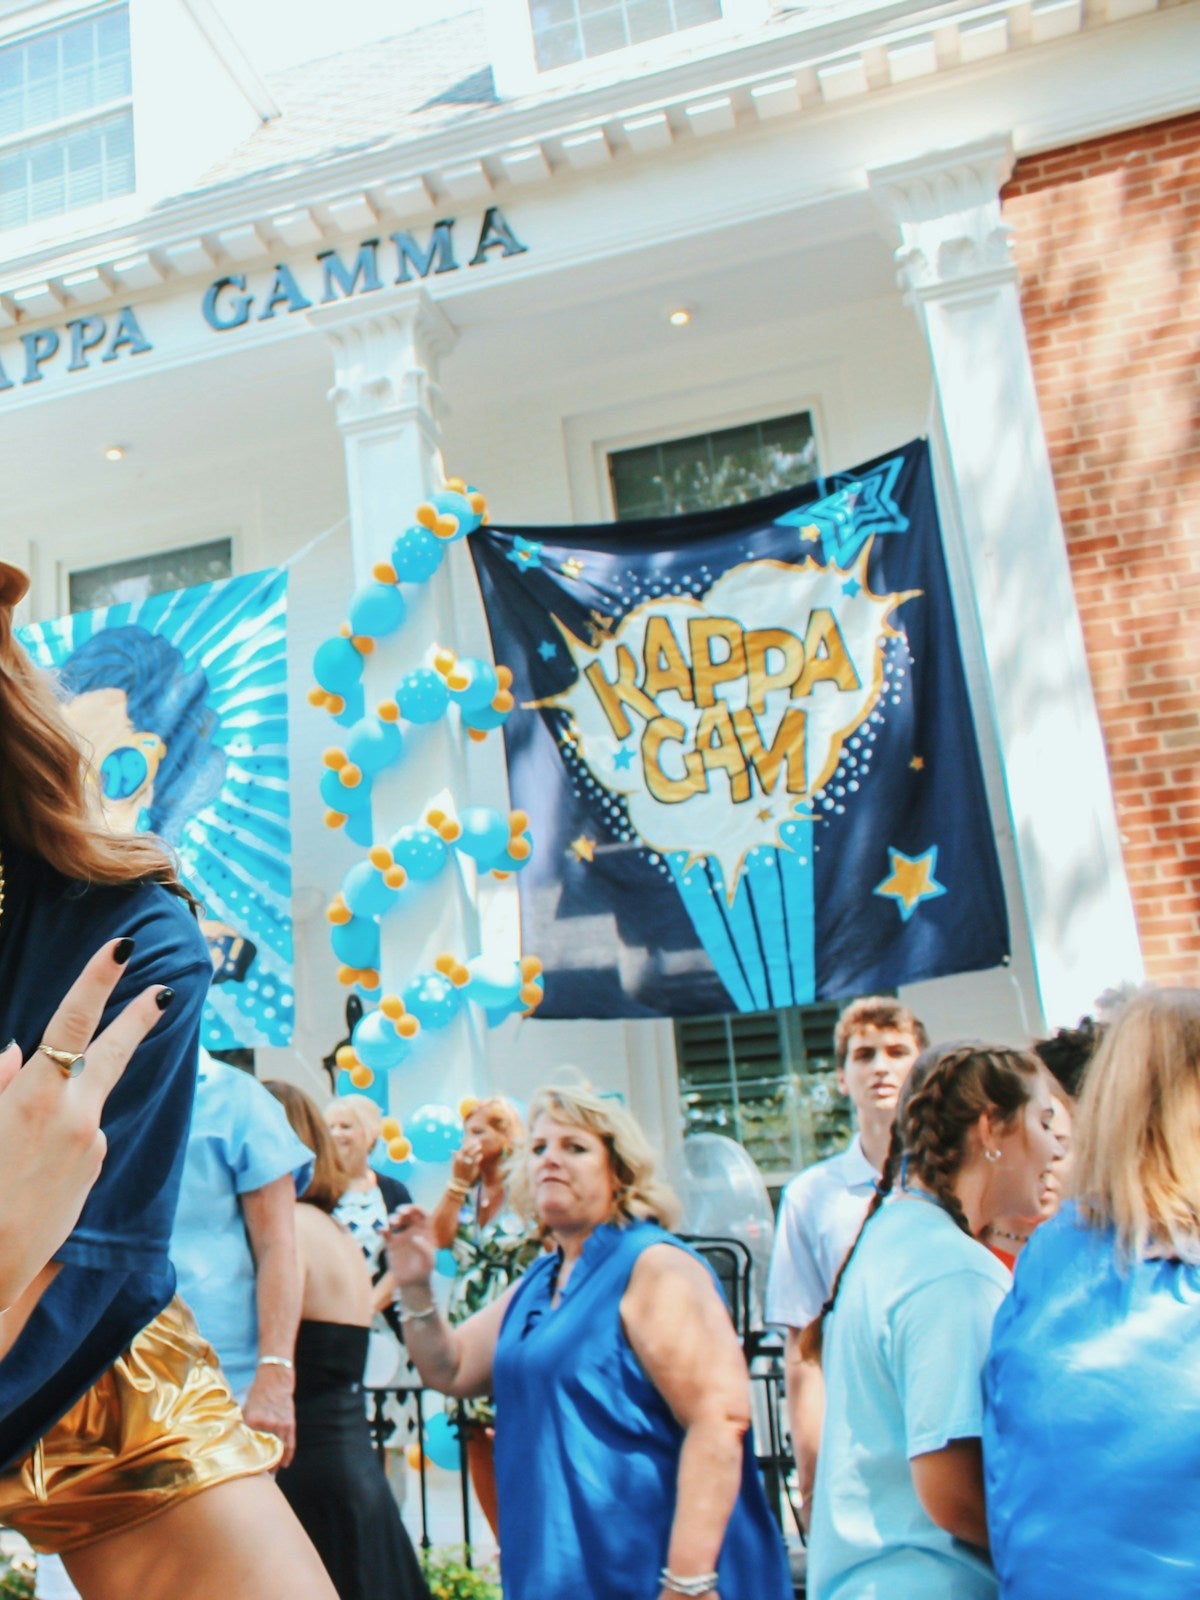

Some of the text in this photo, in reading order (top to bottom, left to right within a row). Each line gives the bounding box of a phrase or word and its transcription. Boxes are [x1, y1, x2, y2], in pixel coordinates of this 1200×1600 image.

[202, 207, 528, 331] GAMMA
[584, 608, 862, 740] KAPPA
[641, 702, 808, 805] GAM
